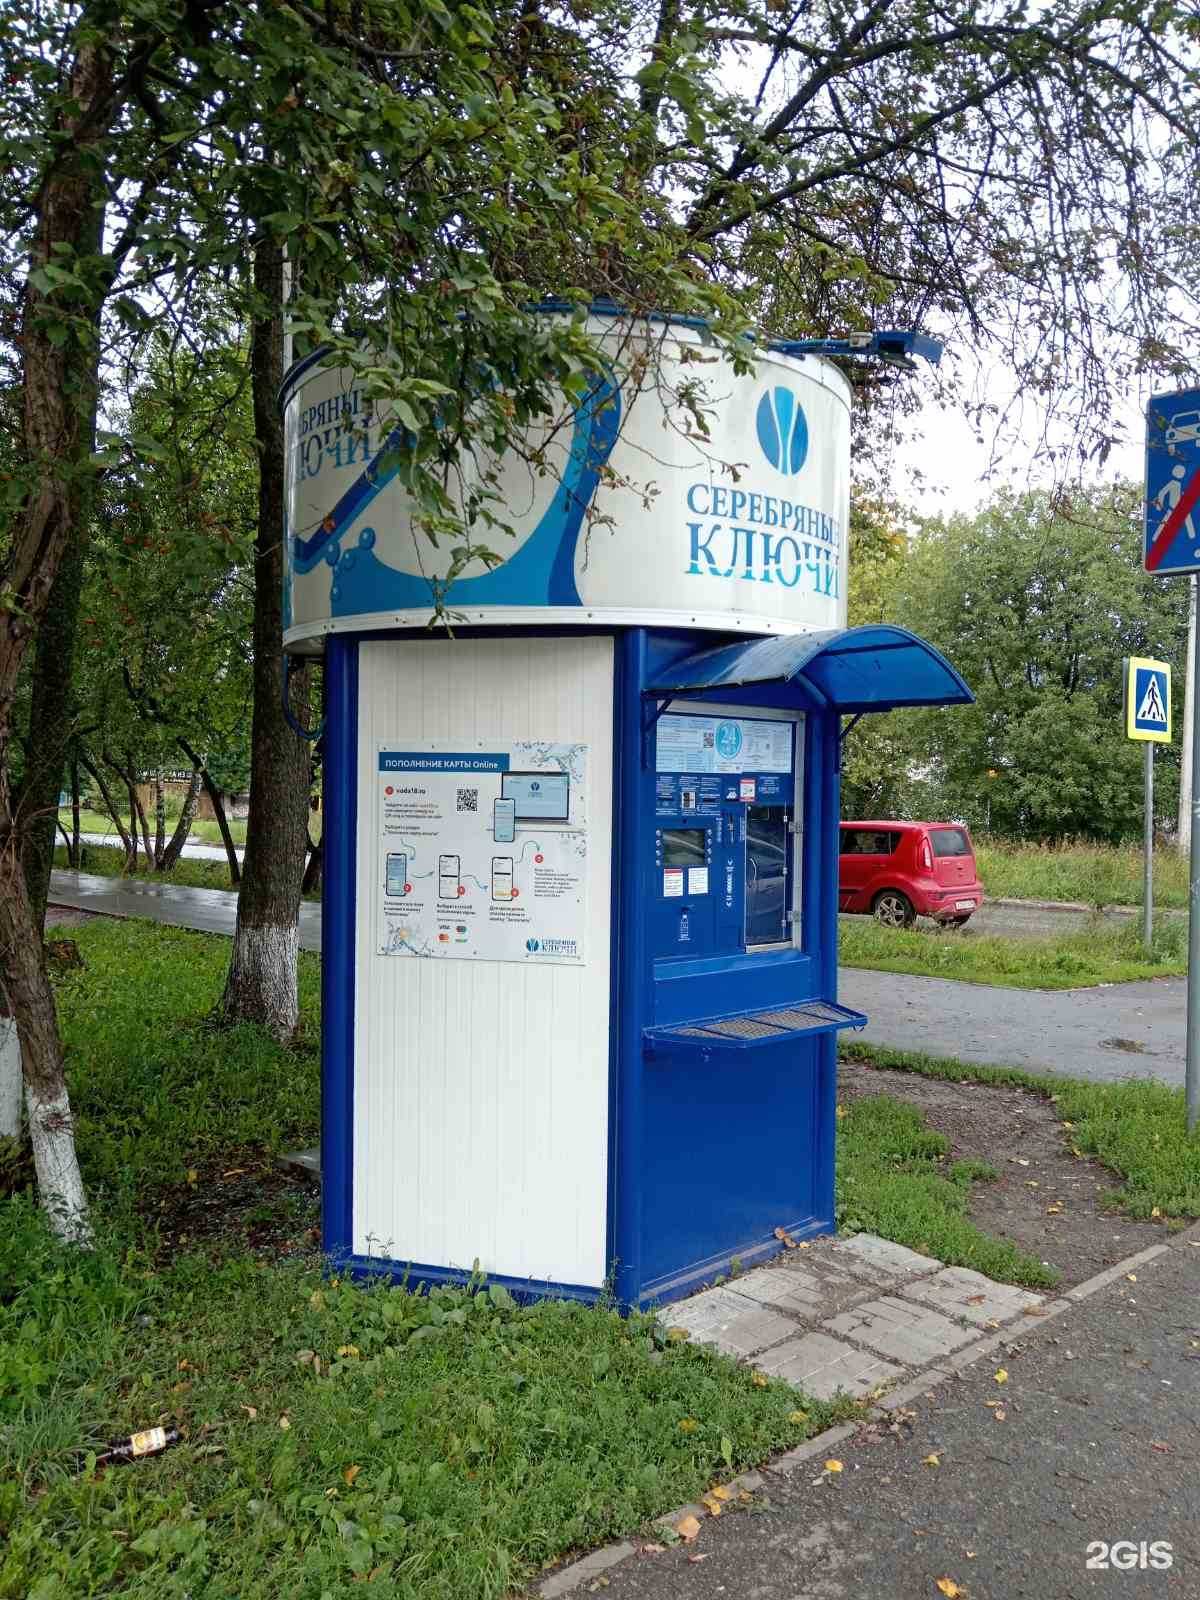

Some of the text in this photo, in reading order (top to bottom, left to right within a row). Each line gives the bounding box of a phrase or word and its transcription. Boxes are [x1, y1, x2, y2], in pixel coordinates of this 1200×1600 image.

[302, 388, 366, 434] БРЯНЫ
[684, 521, 839, 600] КЛЮЧИ
[385, 759, 498, 769] ПОПОЛНЕНИЕ КАРТЫ Online
